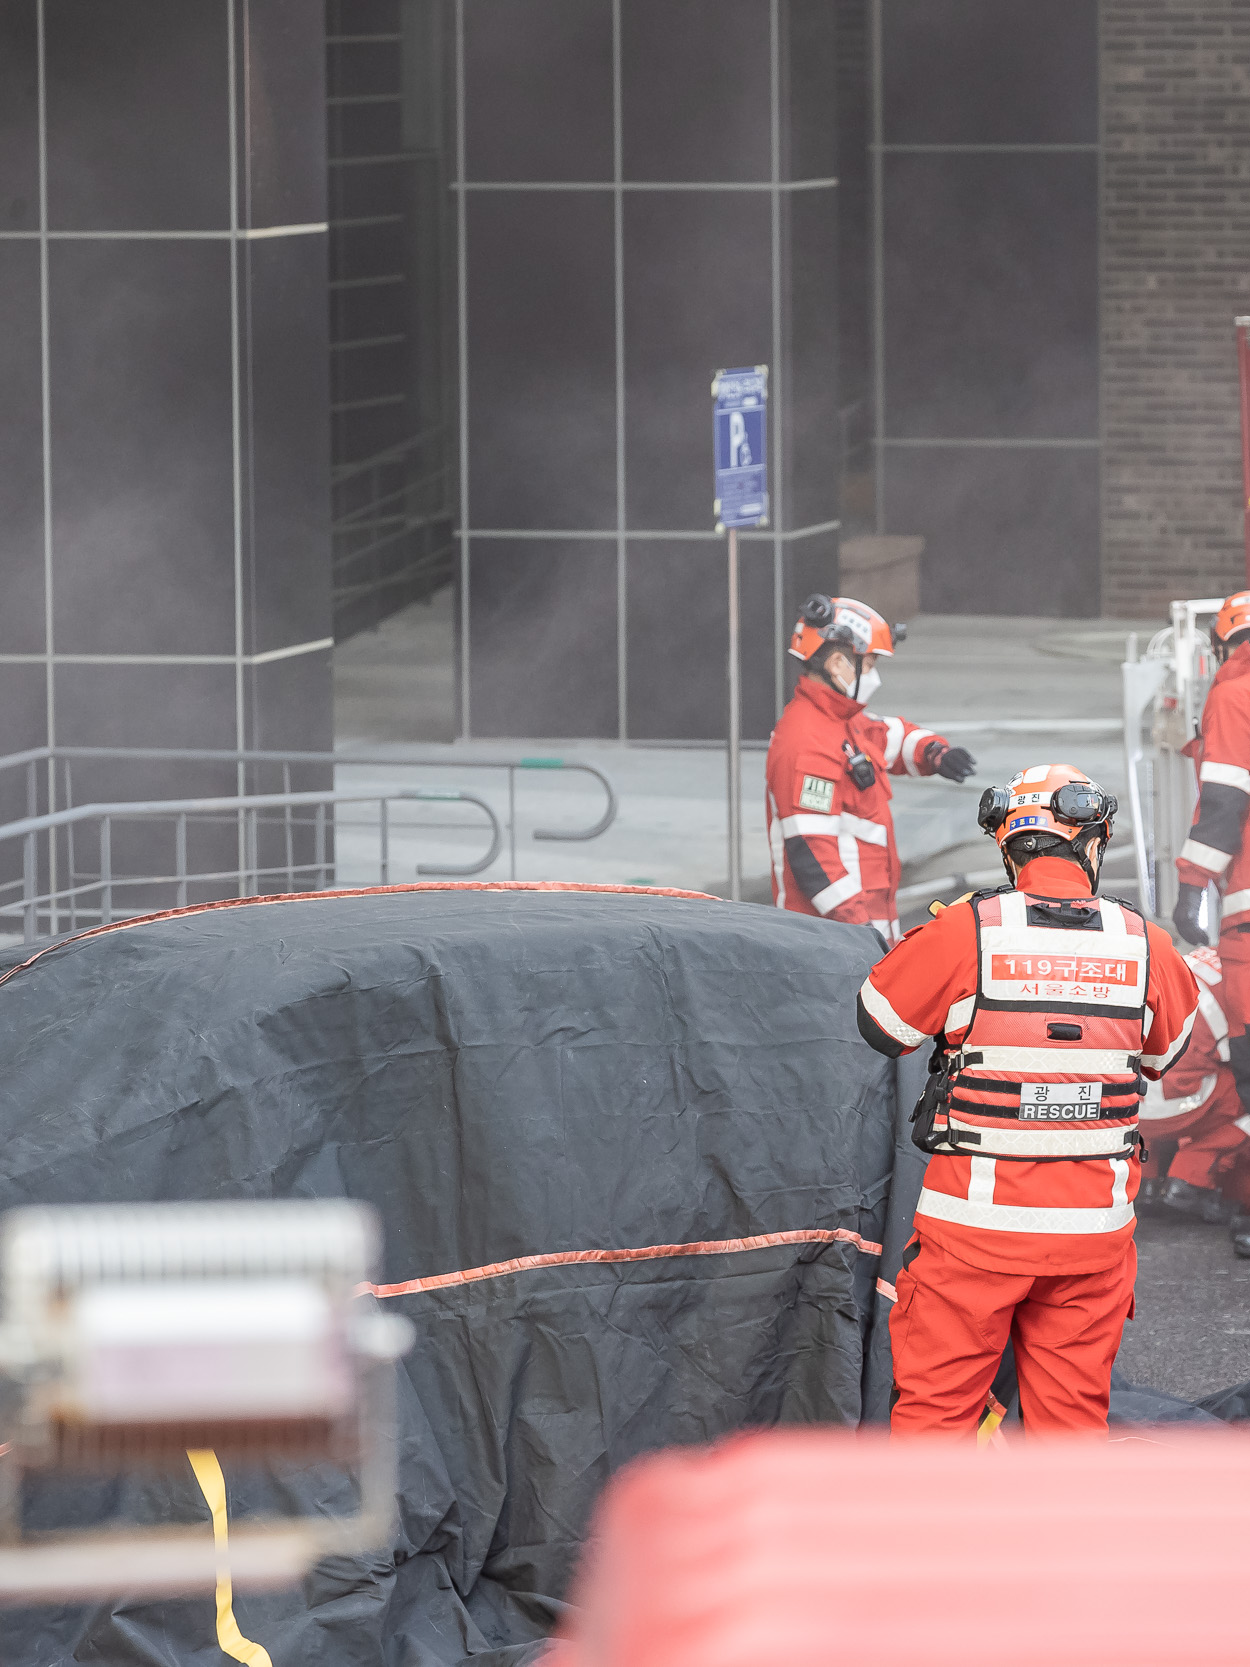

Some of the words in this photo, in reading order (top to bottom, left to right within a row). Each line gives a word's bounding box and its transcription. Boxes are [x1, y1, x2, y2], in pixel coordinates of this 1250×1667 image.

[1004, 957, 1127, 983] 119구조대
[1020, 982, 1111, 1000] 서울소방
[1023, 1103, 1098, 1119] RESCUE
